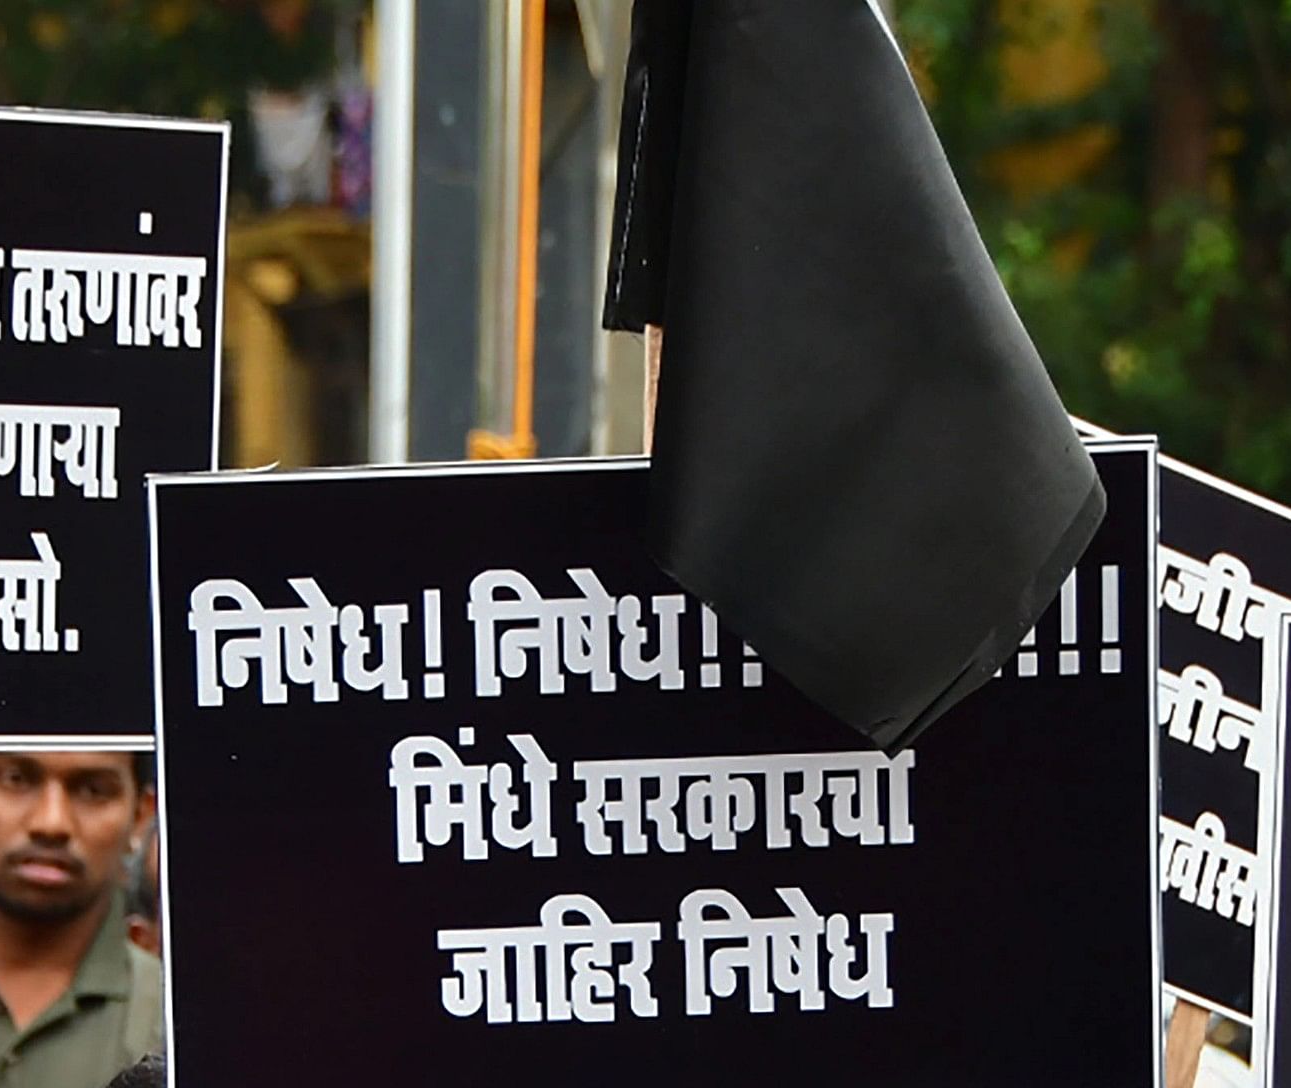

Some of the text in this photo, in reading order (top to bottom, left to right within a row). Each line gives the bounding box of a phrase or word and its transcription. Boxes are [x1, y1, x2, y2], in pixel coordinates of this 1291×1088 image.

[188, 578, 445, 706] निषेध!
[389, 727, 915, 863] मिंधे सरकारचा
[438, 888, 894, 1024] जाहिर निषेध
